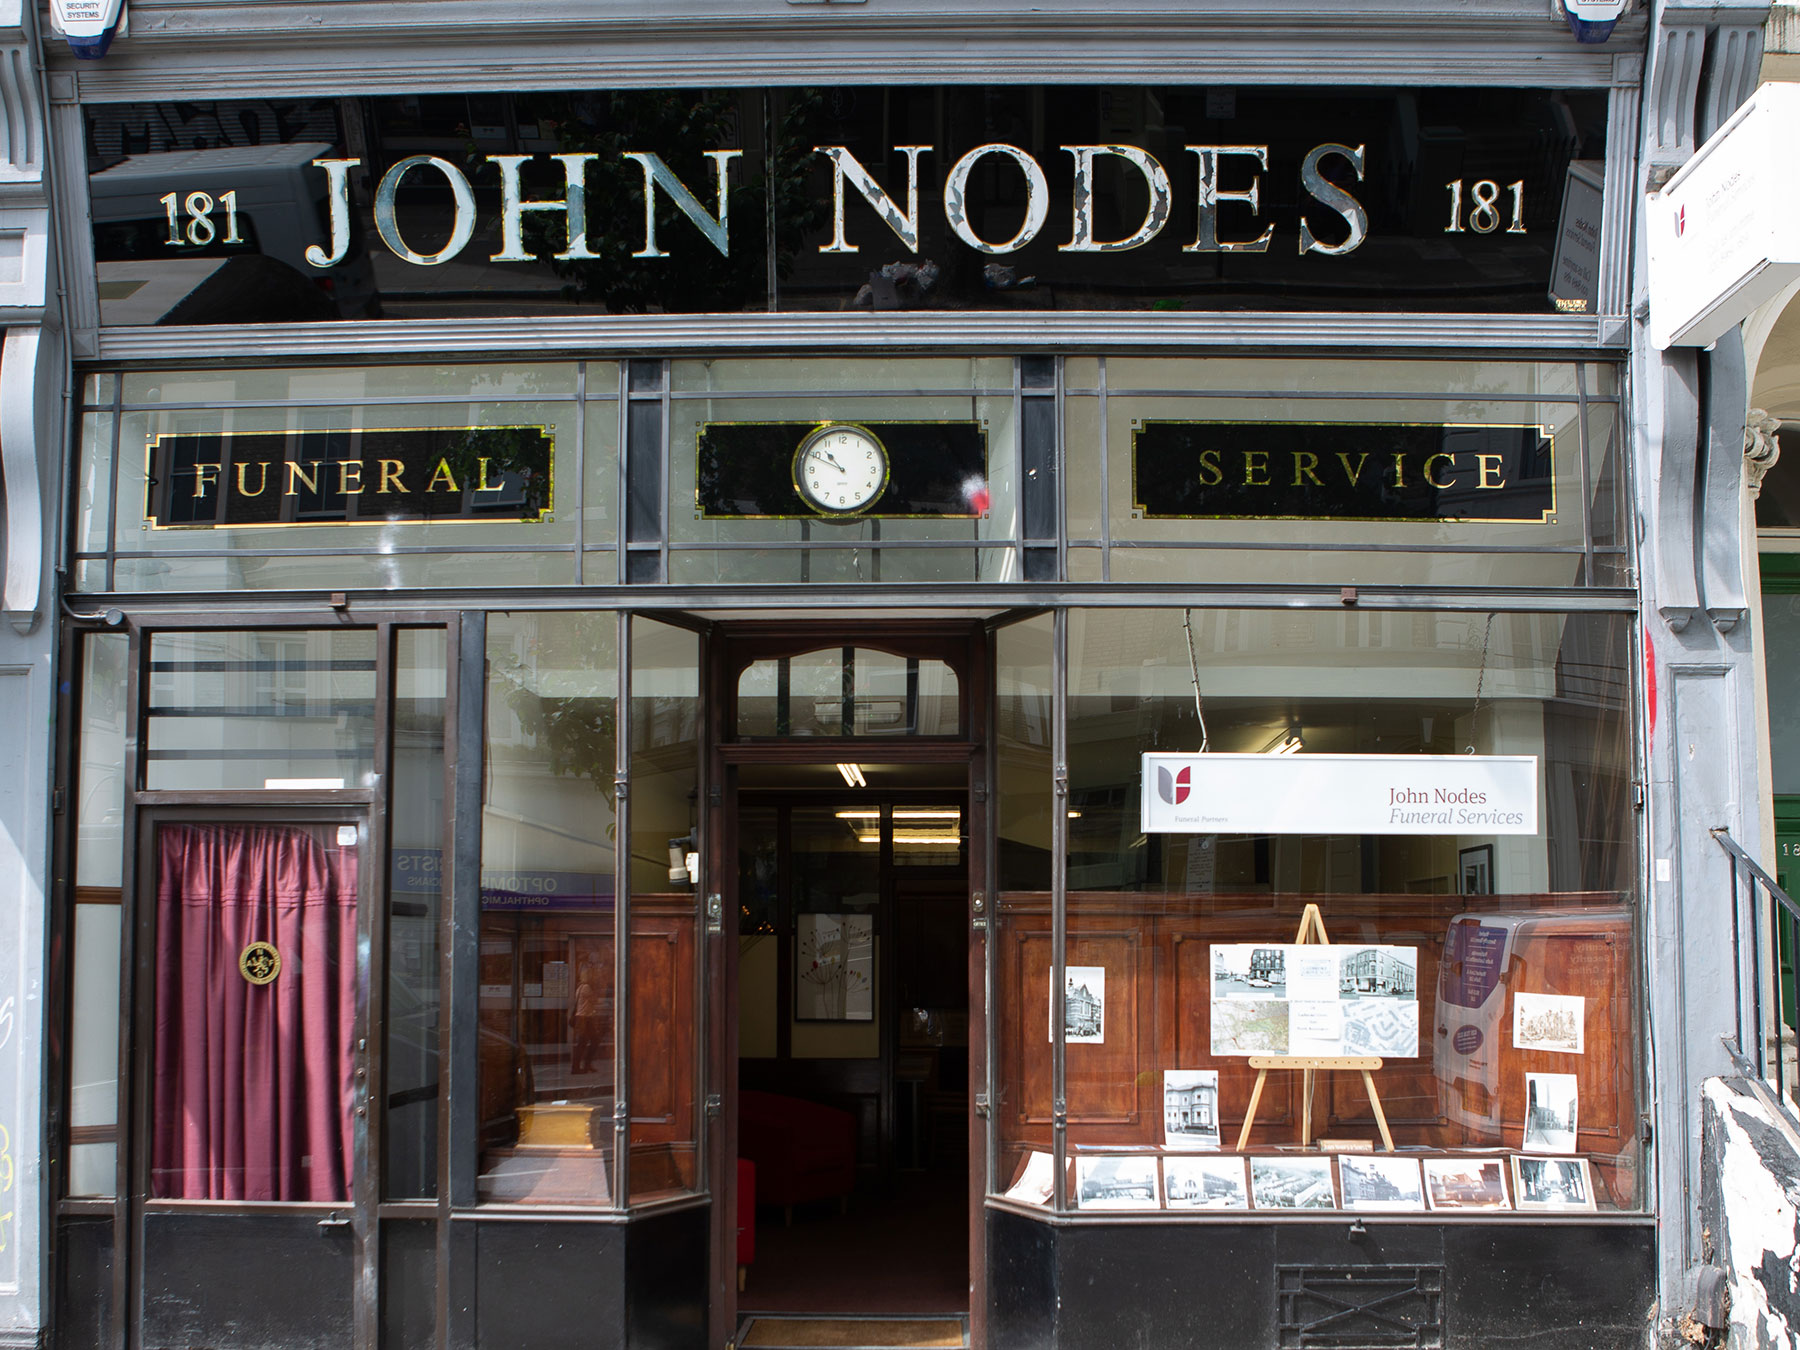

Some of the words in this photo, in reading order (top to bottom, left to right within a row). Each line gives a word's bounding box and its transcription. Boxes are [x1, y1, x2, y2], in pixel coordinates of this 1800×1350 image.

[66, 2, 101, 10] SECURITY
[67, 11, 100, 19] SYSTEMS
[159, 190, 245, 246] 181
[304, 150, 745, 268] JOHN
[813, 142, 1368, 256] NODES
[1444, 179, 1528, 234] 181
[824, 439, 831, 448] 11
[838, 436, 848, 444] 12
[856, 440, 860, 448] 1
[866, 451, 873, 459] 2
[809, 466, 815, 474] 9
[870, 466, 877, 474] 3
[1198, 451, 1507, 489] SERVICE
[193, 457, 506, 499] FUNERAL
[813, 481, 819, 489] 8
[824, 492, 830, 500] 7
[839, 496, 846, 504] 6
[854, 492, 861, 500] 5
[1389, 787, 1430, 806] John
[1434, 787, 1487, 804] Nodes
[1174, 815, 1200, 823] Funeral
[1389, 808, 1455, 825] Funeral
[1456, 808, 1524, 825] Services
